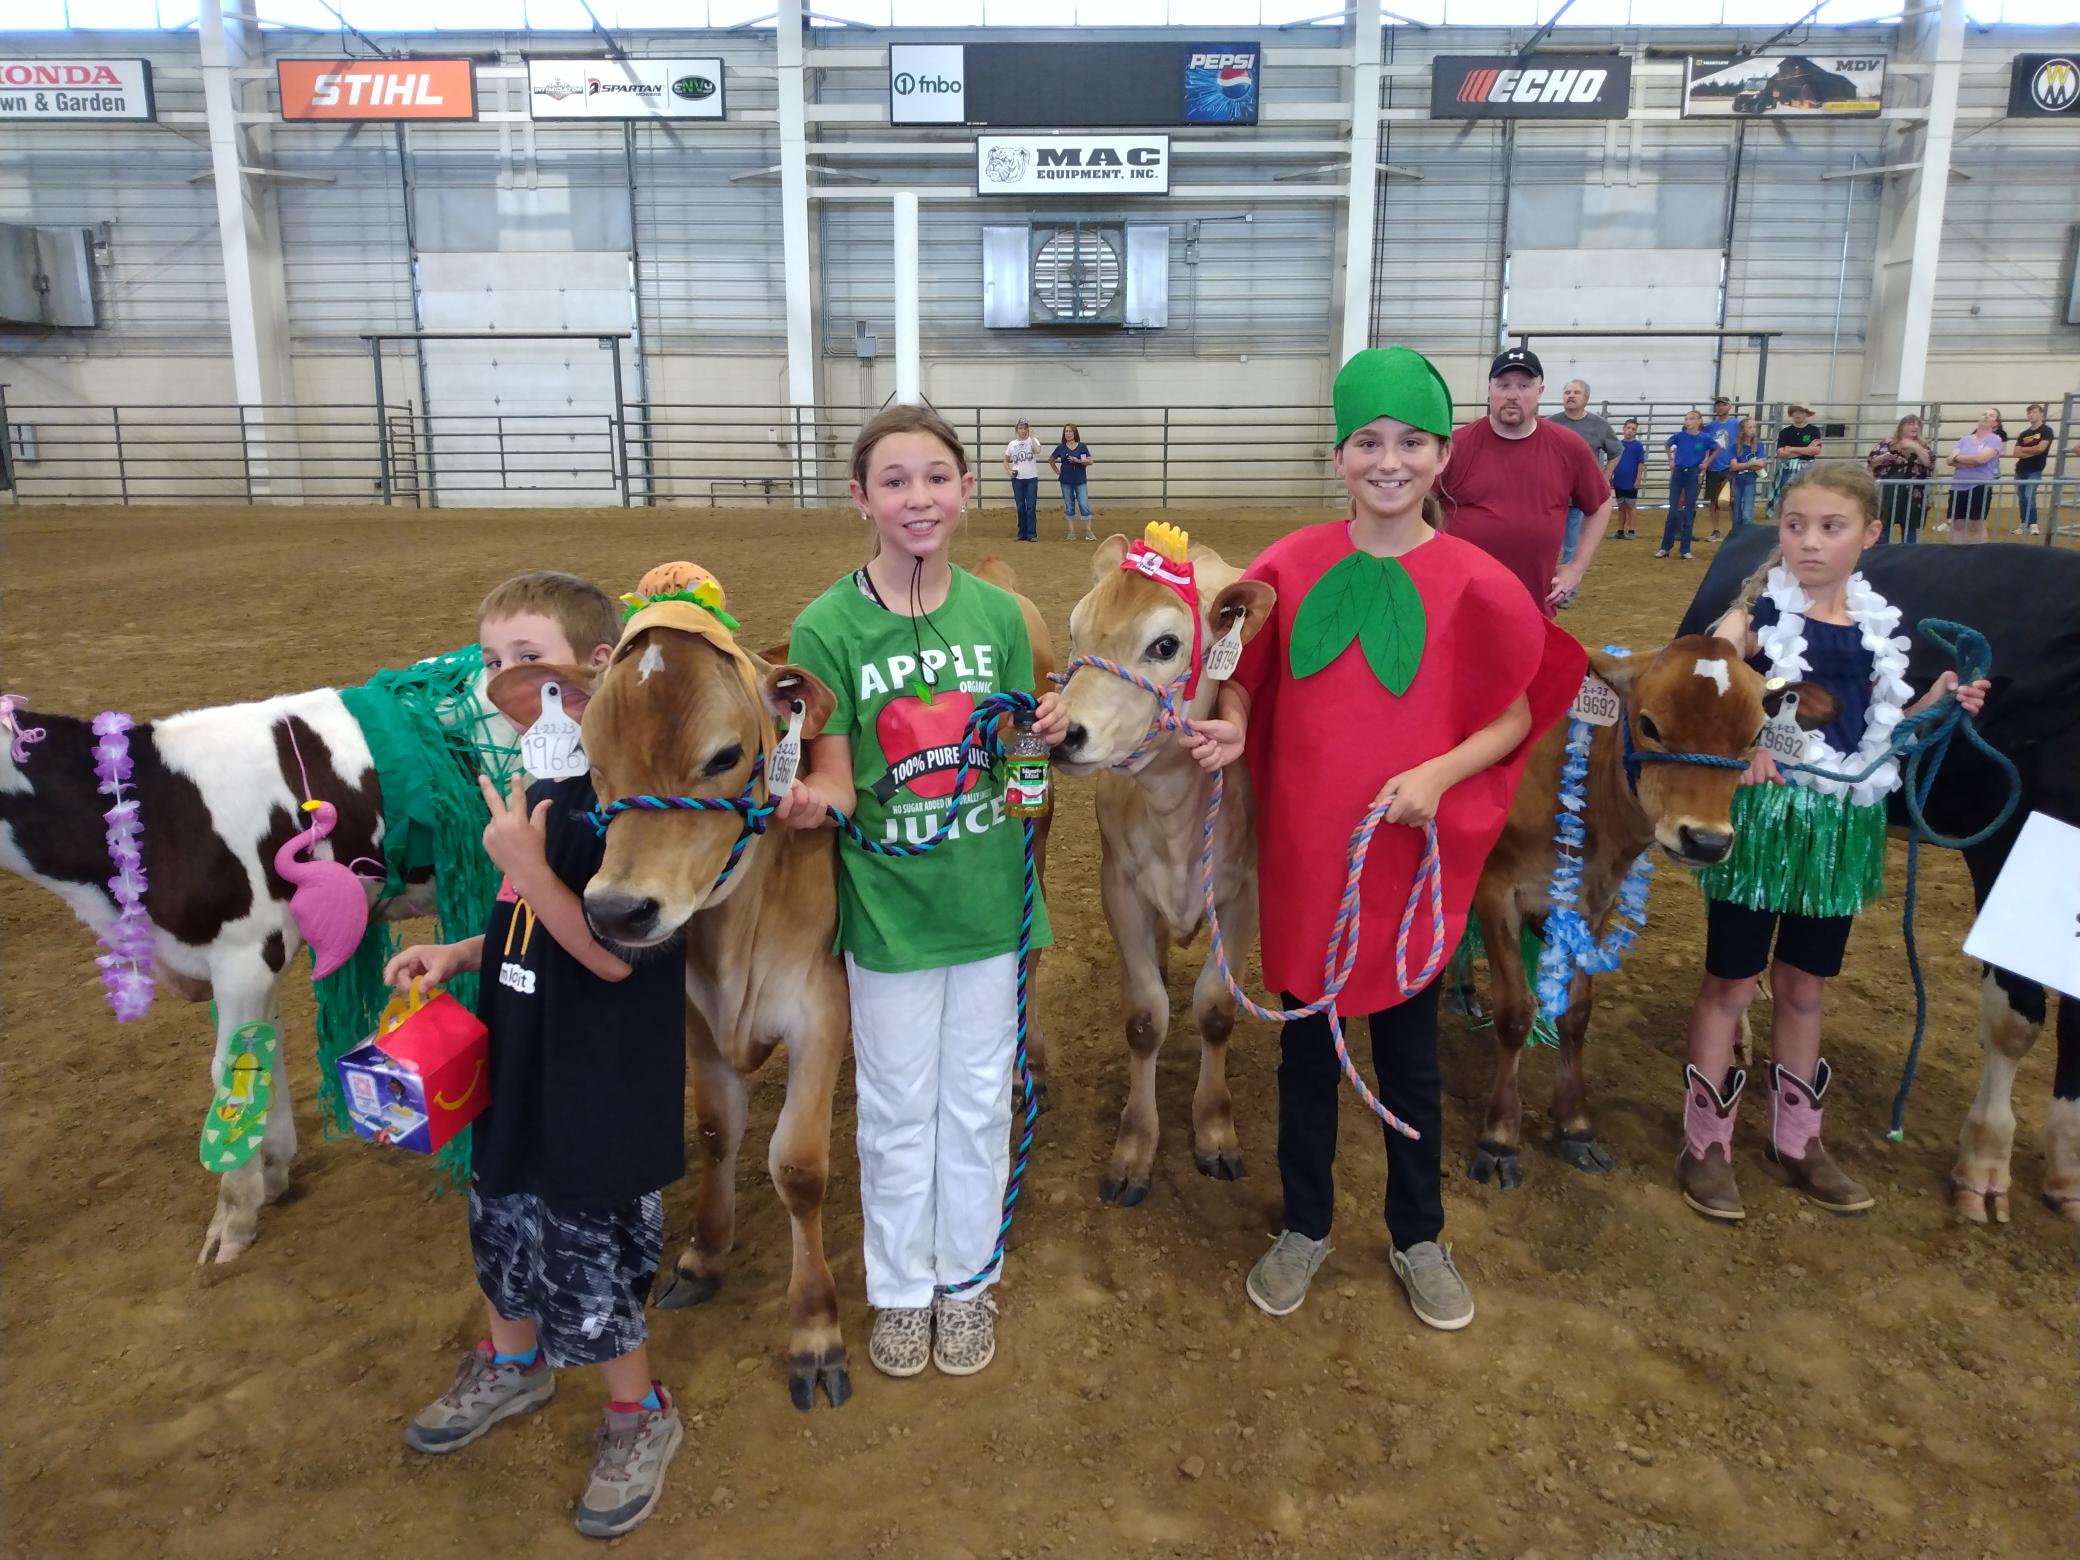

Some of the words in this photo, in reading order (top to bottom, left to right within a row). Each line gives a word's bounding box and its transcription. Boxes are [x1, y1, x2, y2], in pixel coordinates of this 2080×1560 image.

[1190, 54, 1255, 69] PEPSI
[1836, 60, 1880, 71] MDV
[0, 66, 122, 84] ONDA
[918, 75, 962, 93] fnbo
[312, 74, 443, 105] STIHL
[1488, 70, 1607, 102] ECHO
[34, 93, 49, 111] &
[55, 93, 126, 111] Garden
[1037, 148, 1160, 166] MAC
[1037, 169, 1124, 180] EQUIPMENT,
[1130, 169, 1158, 179] INC.
[862, 645, 993, 700] APPLE
[960, 681, 992, 693] ORGANIC
[1575, 694, 1616, 718] 19692
[892, 754, 925, 785] 100%
[927, 747, 960, 768] PURE
[968, 748, 990, 769] UICE
[893, 805, 902, 815] NO
[903, 802, 923, 814] SUGAR
[924, 798, 944, 811] ADDED
